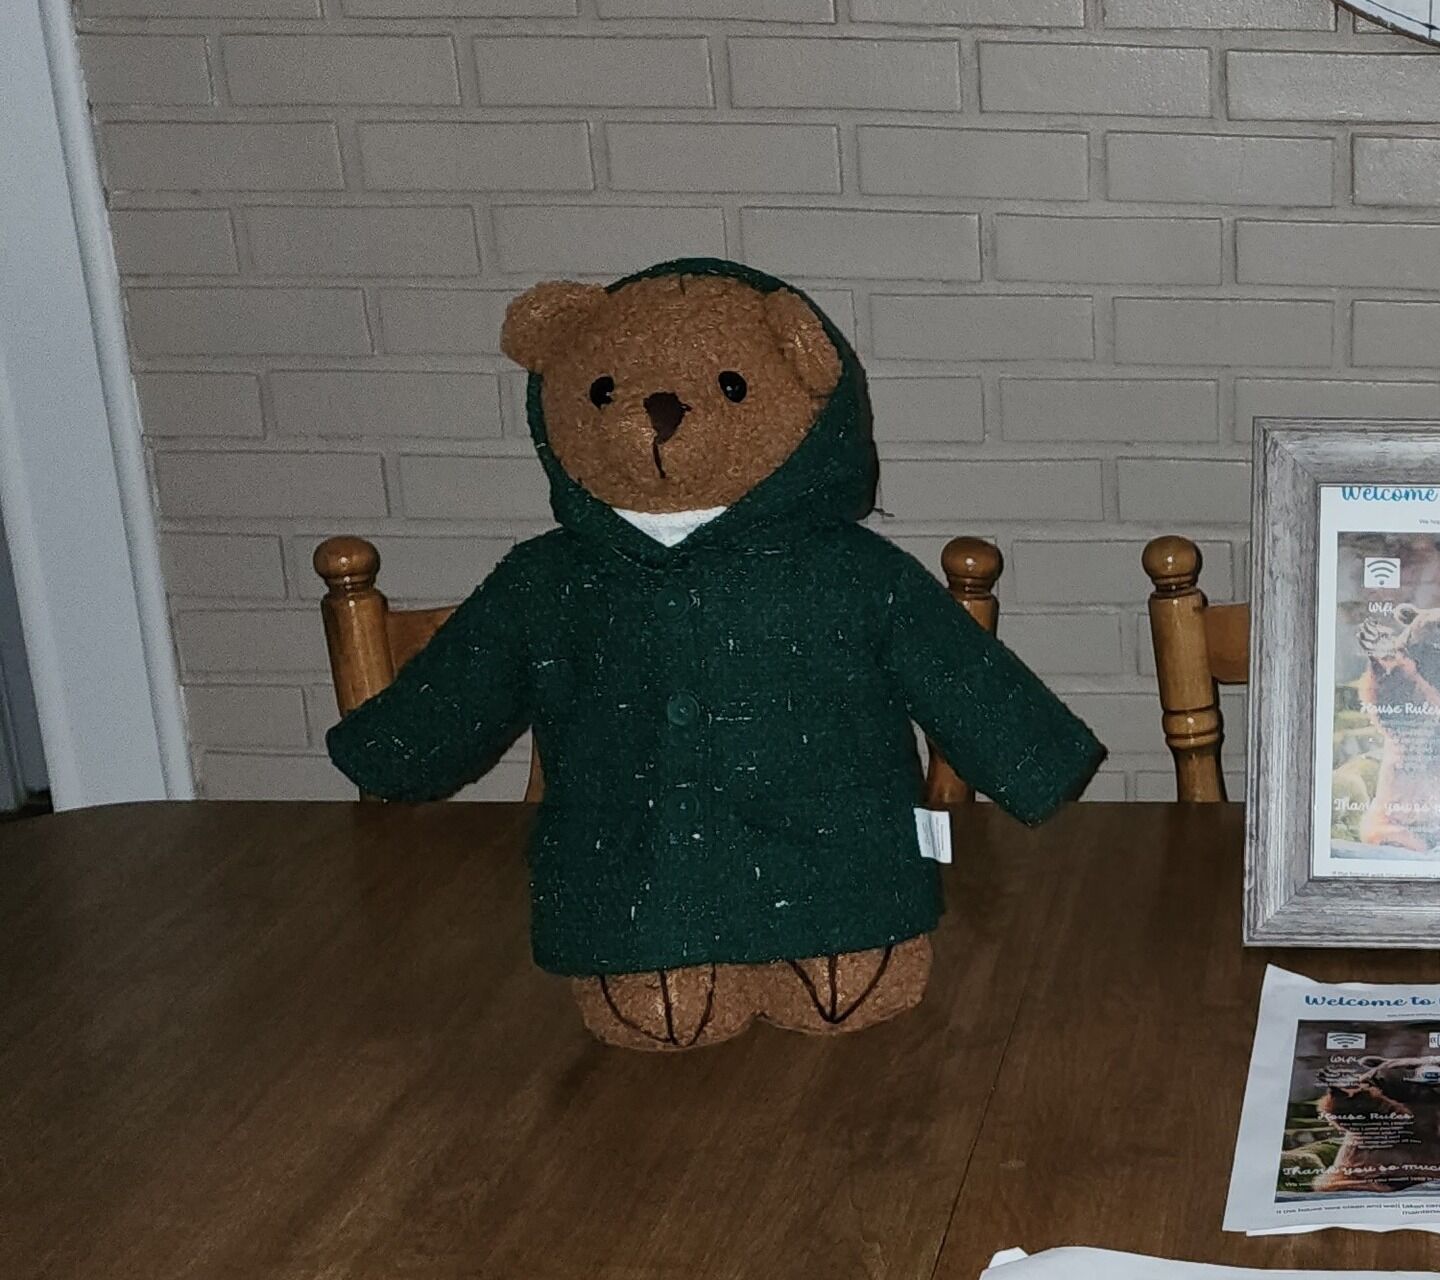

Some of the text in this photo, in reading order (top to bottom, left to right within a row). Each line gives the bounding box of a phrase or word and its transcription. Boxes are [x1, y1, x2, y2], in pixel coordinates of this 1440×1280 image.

[1341, 487, 1438, 501] Welcome
[1305, 995, 1408, 1007] Welcome
[1410, 995, 1435, 1007] to
